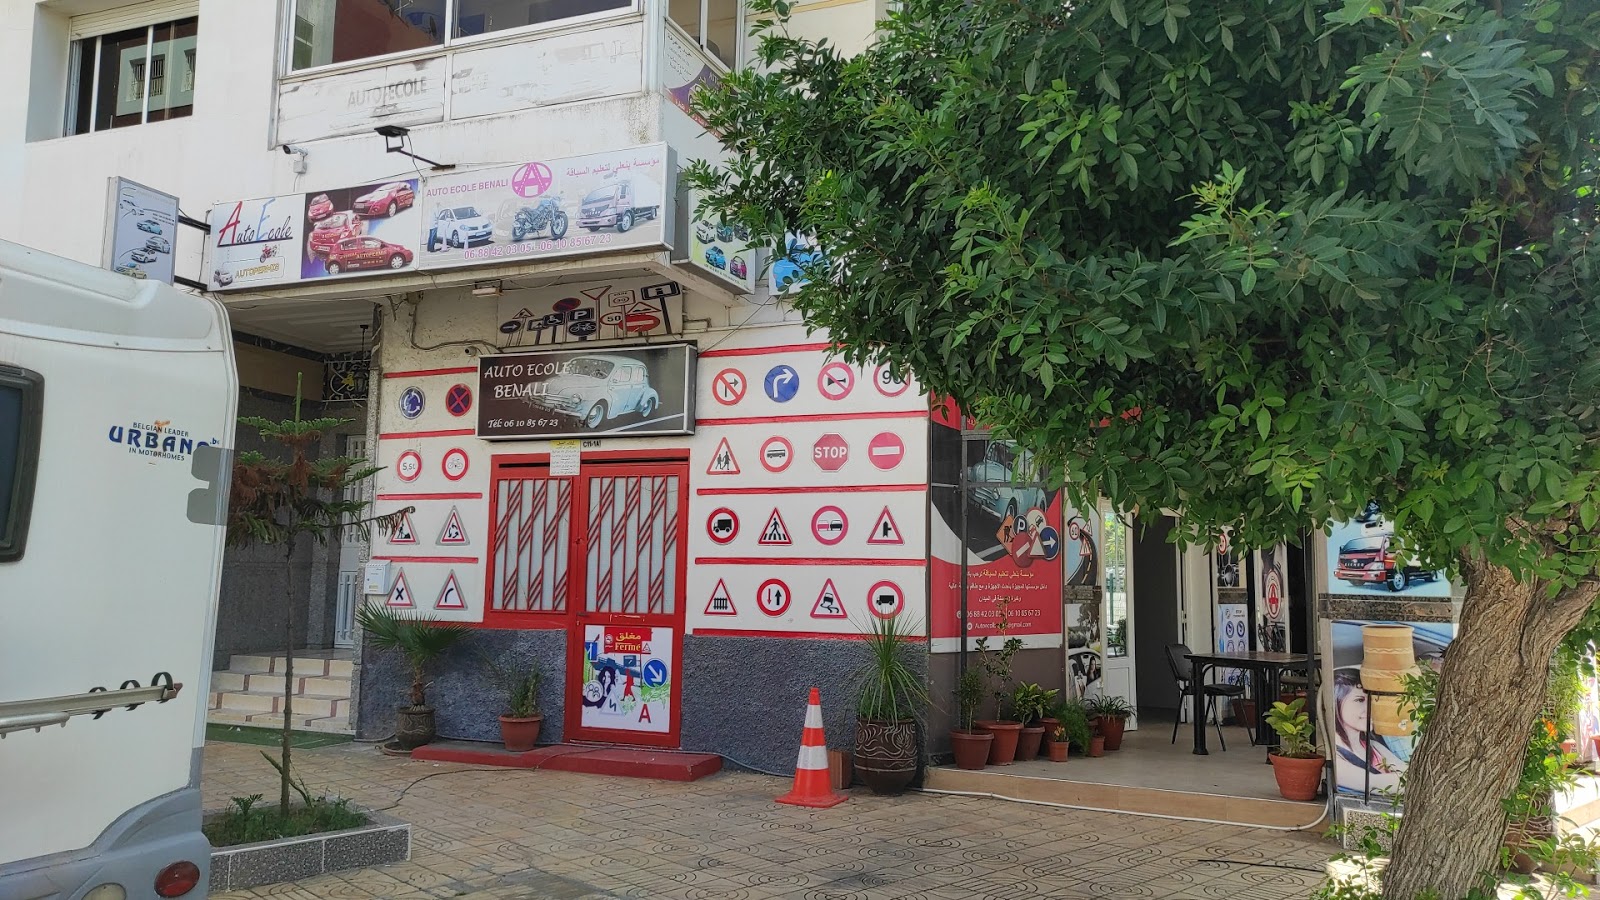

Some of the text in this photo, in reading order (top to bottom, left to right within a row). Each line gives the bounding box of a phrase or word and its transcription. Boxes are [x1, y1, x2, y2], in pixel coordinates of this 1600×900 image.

[426, 179, 509, 197] AUTO ECOLE BENALI
[217, 196, 292, 246] Auto Ecole
[464, 250, 475, 260] 06
[478, 248, 489, 258] 88
[491, 247, 502, 257] 42
[506, 245, 517, 255] 03
[520, 243, 532, 253] 05
[540, 241, 552, 251] 06
[556, 239, 567, 249] 10
[569, 237, 581, 247] 85
[584, 235, 596, 246] 67
[599, 233, 612, 244] 23
[574, 310, 588, 320] P
[484, 361, 571, 379] AUTO ECOLE
[494, 382, 550, 399] BENALI
[132, 421, 189, 438] BELGIAN LEADER
[504, 419, 515, 427] 06
[526, 419, 536, 428] 85
[538, 418, 548, 428] 67
[549, 419, 559, 427] 23
[138, 448, 185, 461] MOTORHOMES
[814, 446, 848, 459] STOP
[616, 631, 641, 641] مغلق
[614, 642, 641, 651] Fermé
[638, 703, 652, 724] A
